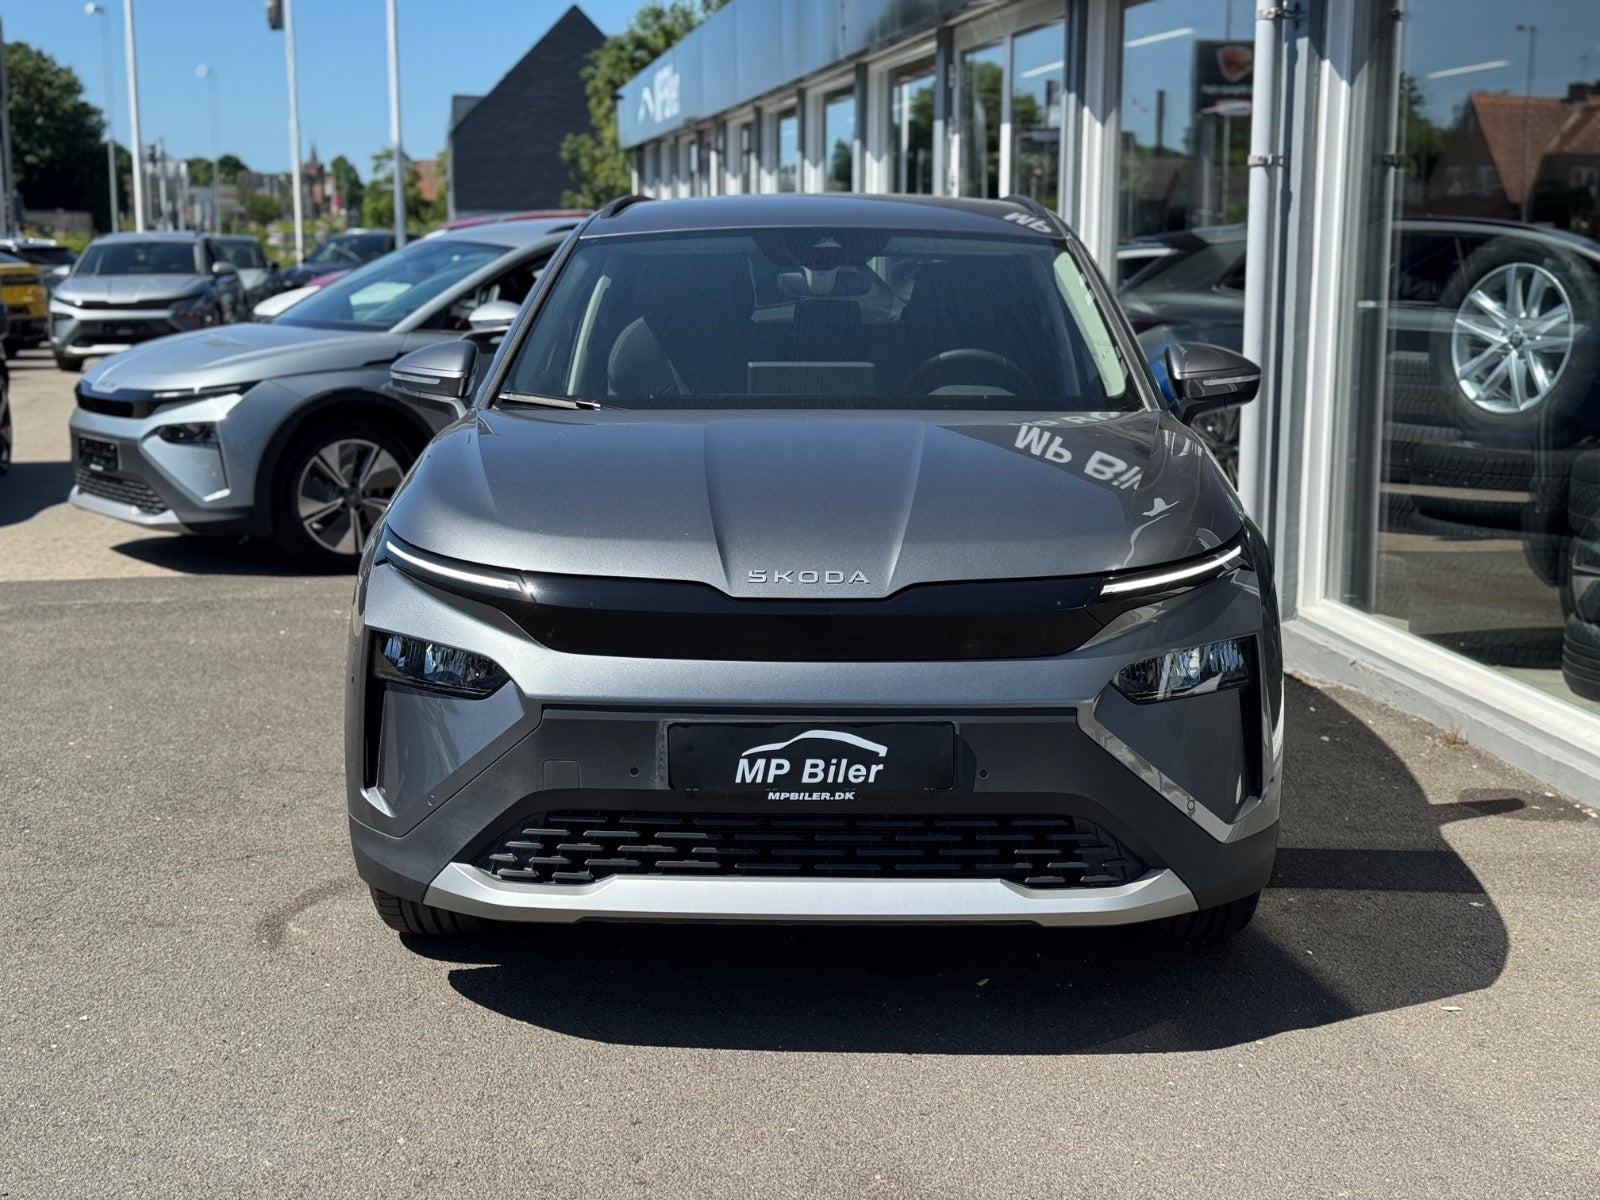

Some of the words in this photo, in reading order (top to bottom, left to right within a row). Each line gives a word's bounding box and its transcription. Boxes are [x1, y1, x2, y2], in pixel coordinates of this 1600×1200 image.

[735, 758, 791, 784] MP
[801, 758, 884, 784] Biler
[767, 791, 856, 801] MPBILER.DK
